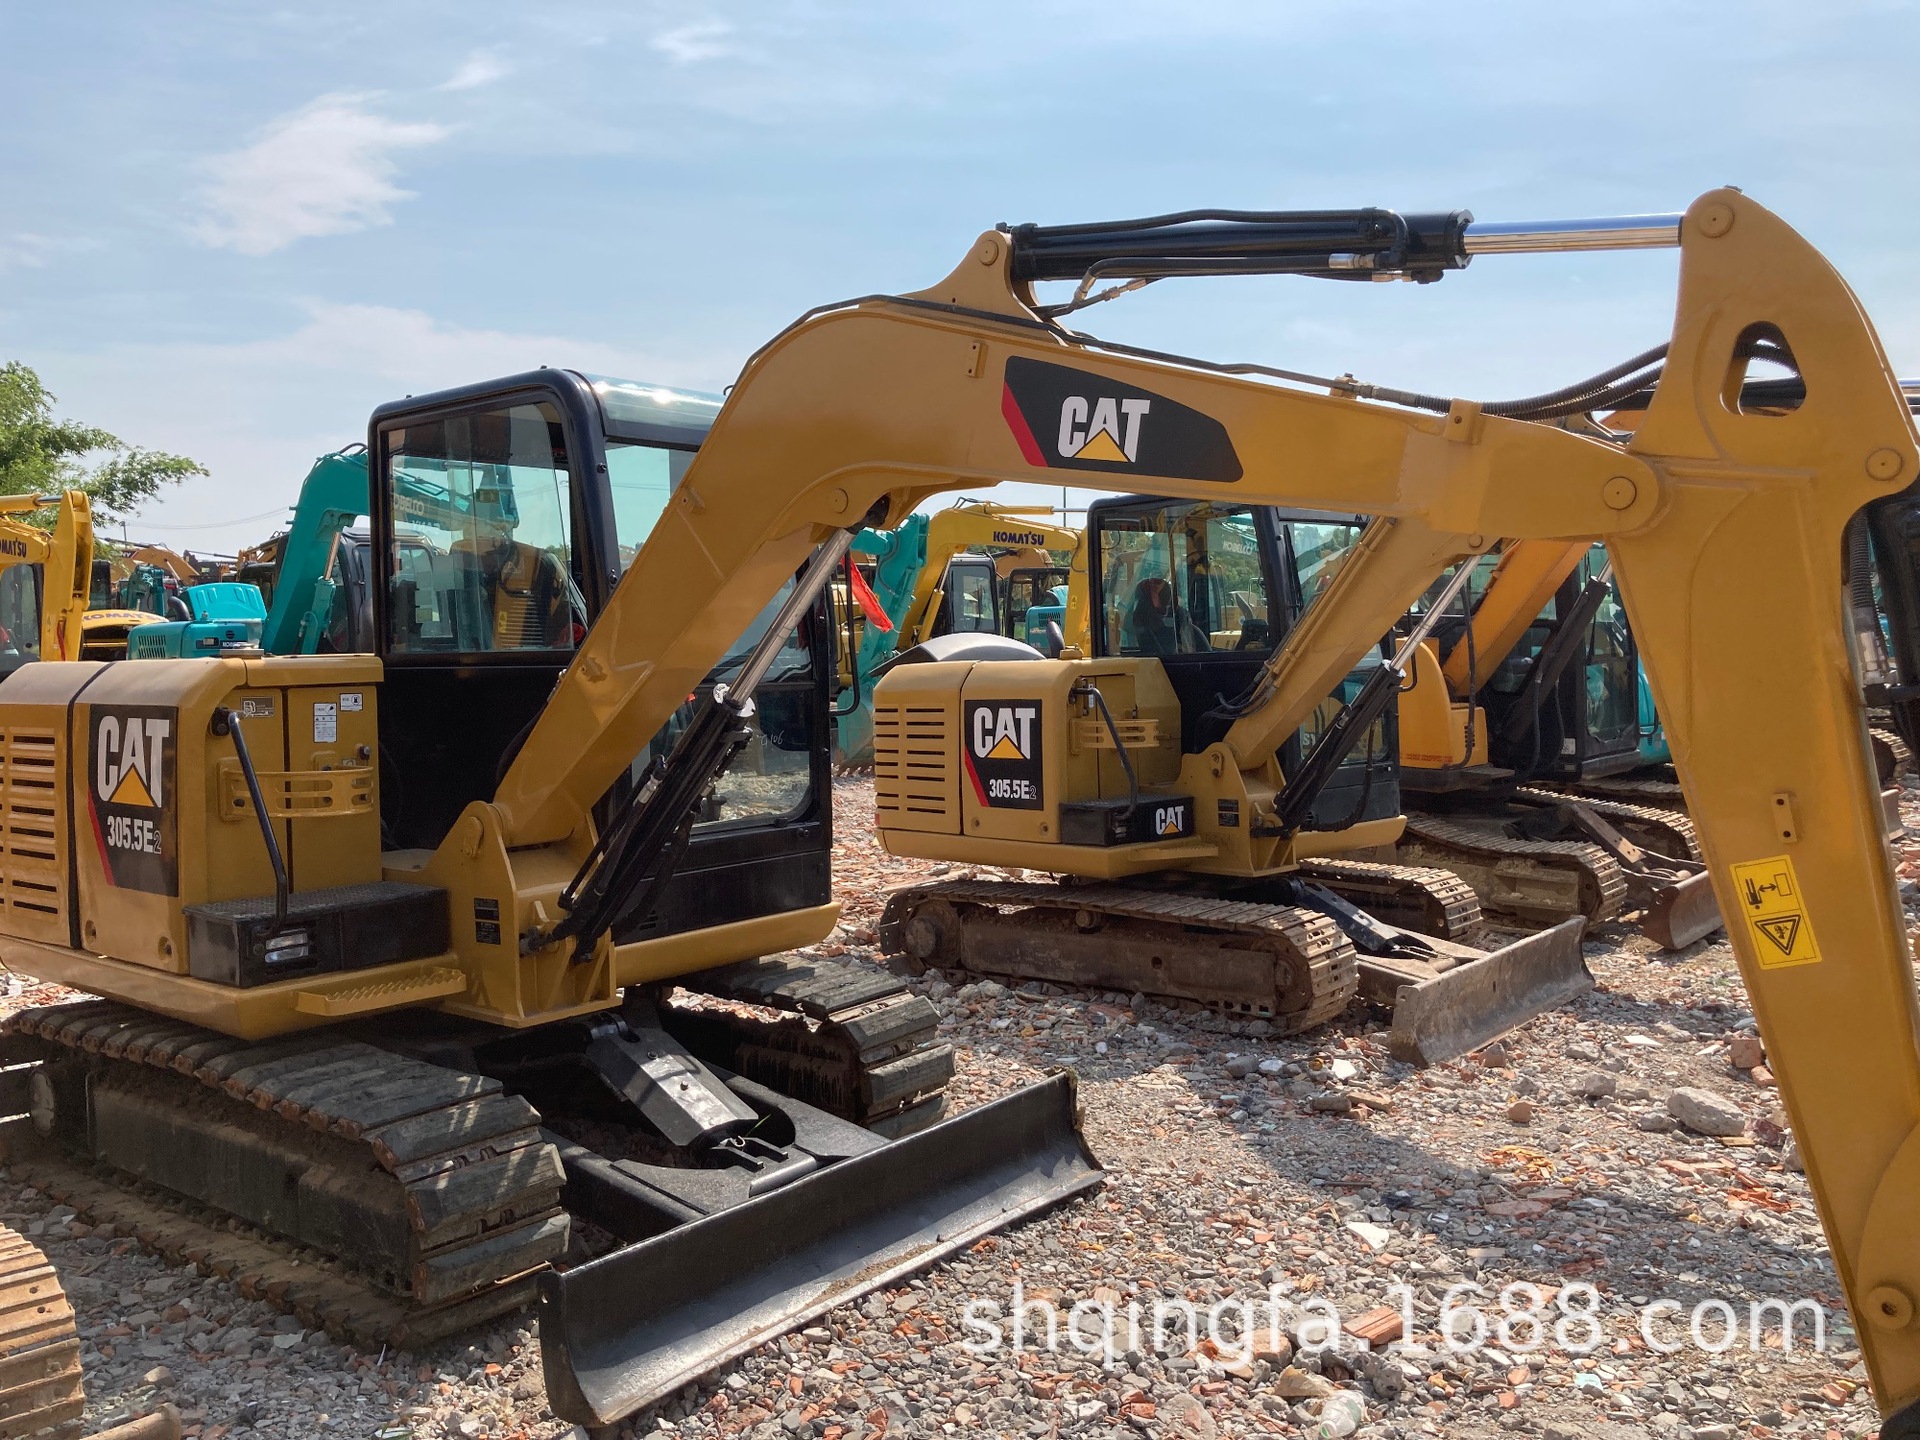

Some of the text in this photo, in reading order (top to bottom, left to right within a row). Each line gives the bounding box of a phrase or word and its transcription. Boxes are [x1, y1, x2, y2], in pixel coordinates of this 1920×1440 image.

[1057, 395, 1151, 463] CAT
[0, 537, 27, 558] MATSU
[993, 531, 1045, 546] KOMATSU
[973, 707, 1036, 760] CAT
[97, 715, 170, 808] CAT
[1155, 805, 1184, 835] CAT
